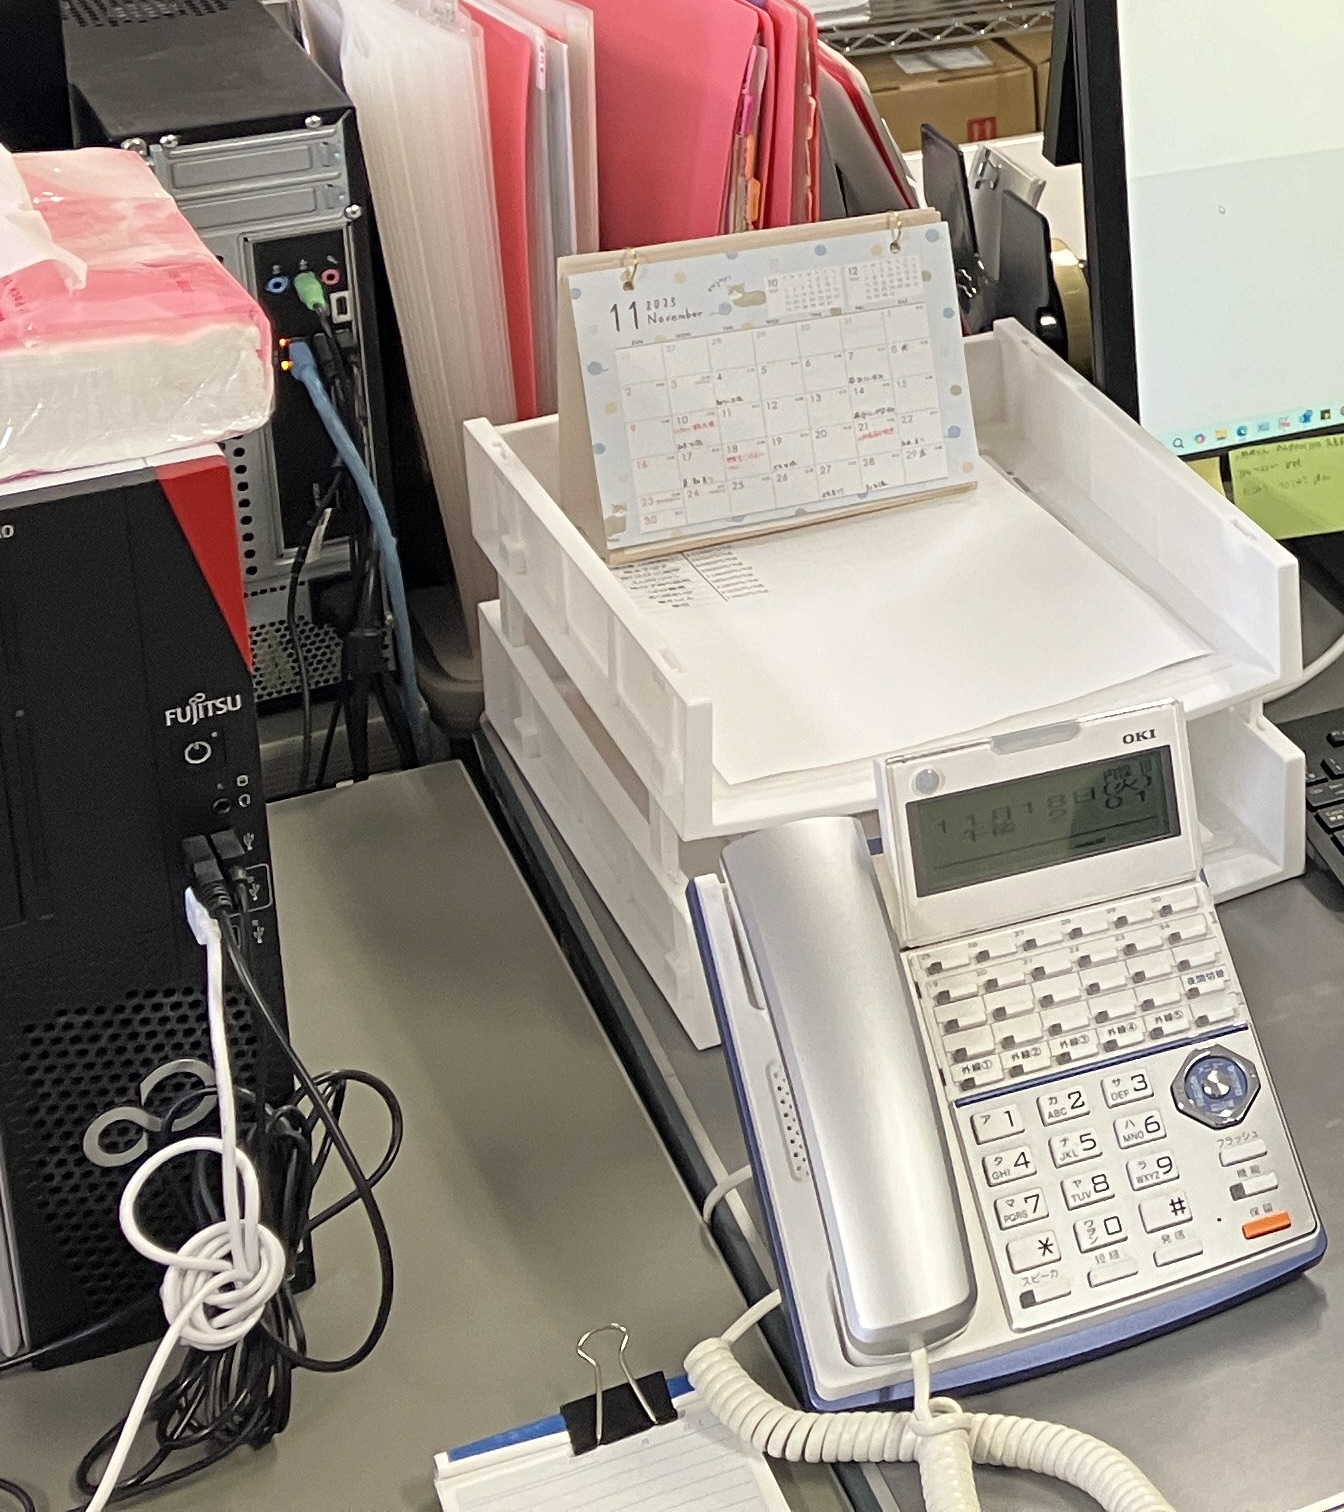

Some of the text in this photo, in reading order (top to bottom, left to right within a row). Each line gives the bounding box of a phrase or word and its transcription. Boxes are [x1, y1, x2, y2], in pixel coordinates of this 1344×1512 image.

[645, 296, 677, 311] 2025
[609, 300, 704, 333] 11 November
[630, 379, 908, 434] 9 10 11 12 13 14 15
[635, 415, 914, 470] 16 17 18 19 20 21 22
[640, 449, 917, 506] 23 24 25 26 27 28 29
[164, 692, 242, 728] FUJITSU
[1121, 727, 1157, 746] OKI
[1130, 1073, 1148, 1092] 3
[1067, 1090, 1085, 1110] 2
[1110, 1089, 1130, 1101] DEF
[1003, 1109, 1014, 1128] 1
[1047, 1106, 1068, 1120] ABC
[1144, 1114, 1161, 1134] 6
[1079, 1132, 1097, 1152] 5
[1122, 1129, 1144, 1143] MNO
[1216, 1130, 1259, 1148] フラッシュ
[1013, 1151, 1031, 1169] 4
[1059, 1149, 1079, 1162] JKL
[991, 1167, 1011, 1181] GHI
[1155, 1155, 1174, 1176] 9
[1091, 1173, 1110, 1194] 8
[1135, 1170, 1161, 1184] WXYZ
[1024, 1193, 1040, 1215] 7
[1071, 1190, 1092, 1203] TUV
[1249, 1202, 1274, 1218] 保留
[1103, 1215, 1123, 1236] 0
[1021, 1269, 1059, 1288] スピーカ
